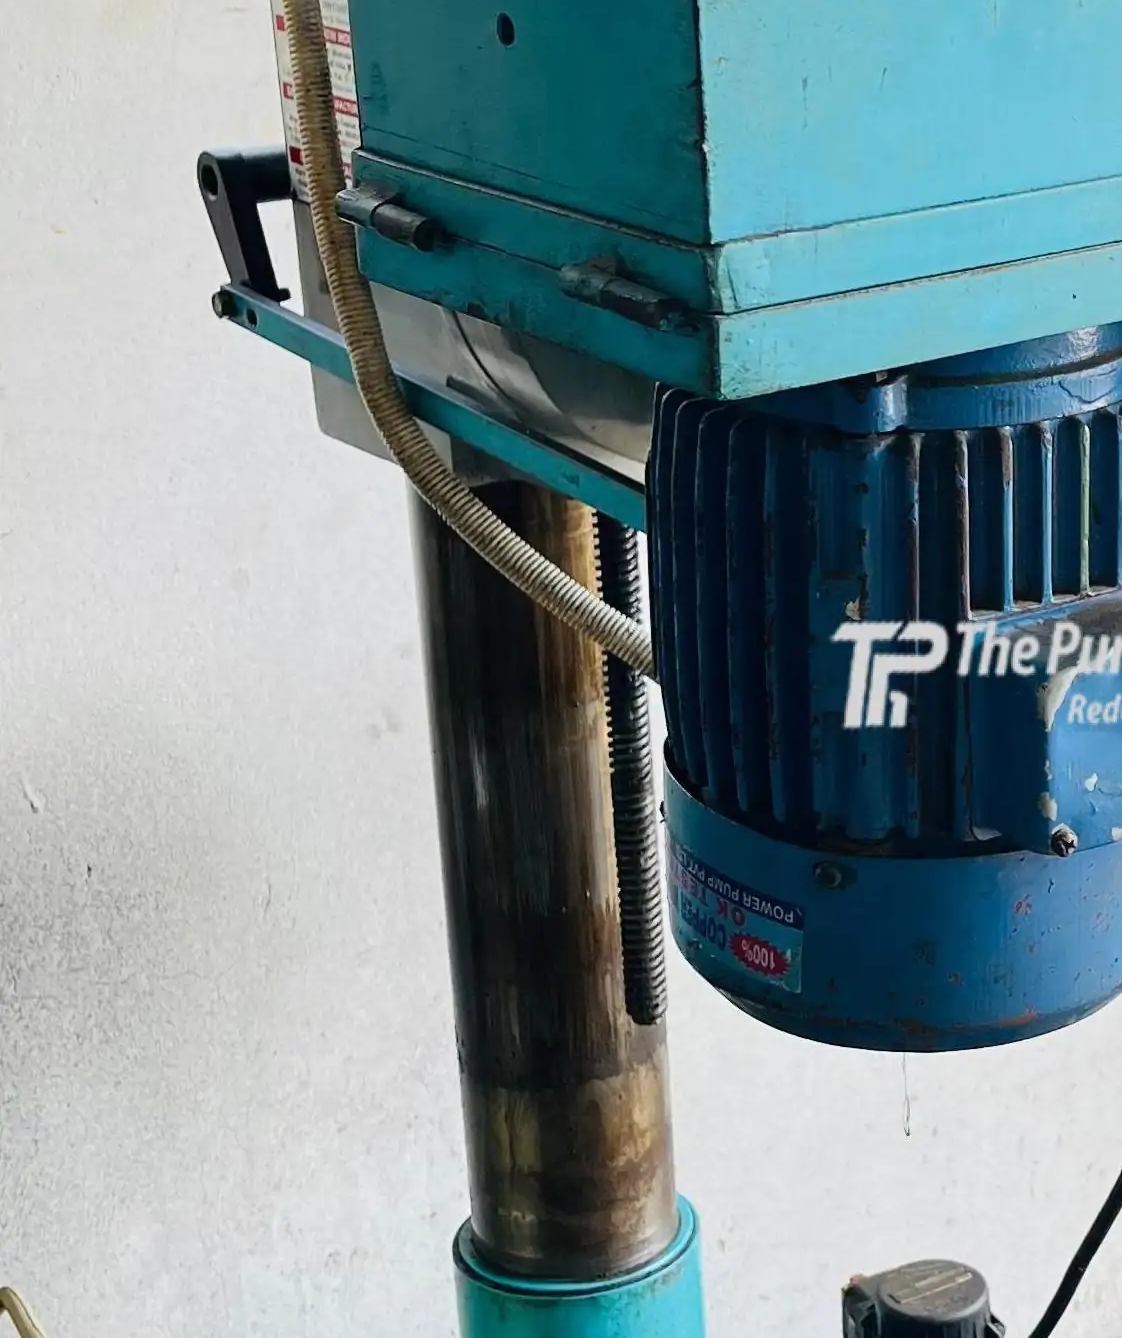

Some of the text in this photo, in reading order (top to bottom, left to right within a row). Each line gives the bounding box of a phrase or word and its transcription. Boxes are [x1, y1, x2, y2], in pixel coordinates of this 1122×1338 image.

[707, 876, 740, 901] PUMP
[743, 893, 794, 923] POWER
[741, 939, 776, 970] 100%
